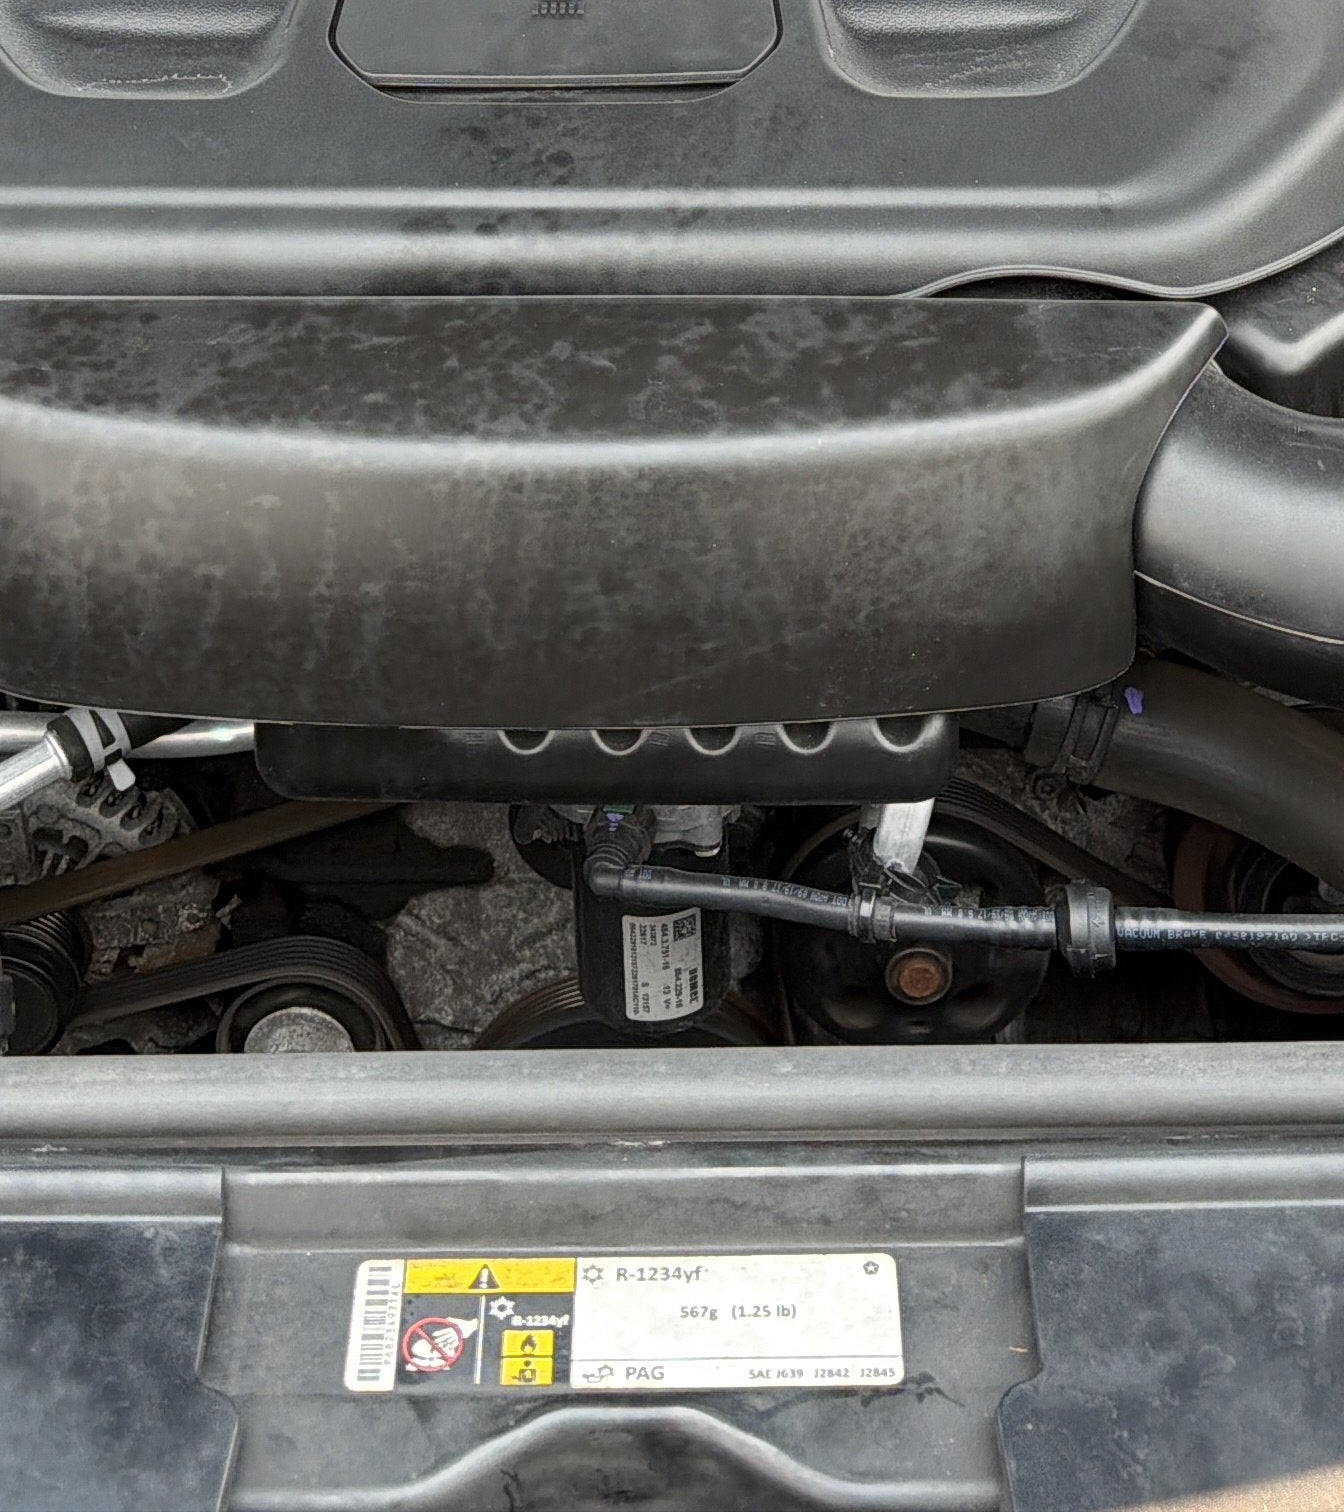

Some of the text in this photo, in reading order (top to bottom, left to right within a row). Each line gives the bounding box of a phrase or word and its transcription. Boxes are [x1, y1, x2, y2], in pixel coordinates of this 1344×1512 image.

[1117, 927, 1161, 940] VACUUM
[616, 1265, 703, 1284] R-1234yf
[680, 1303, 797, 1321] 567g (1.25 lb)
[511, 1314, 570, 1328] R-1234yf
[625, 1365, 665, 1381] PAG
[748, 1367, 896, 1380] SAE J639 J2842 J2845
